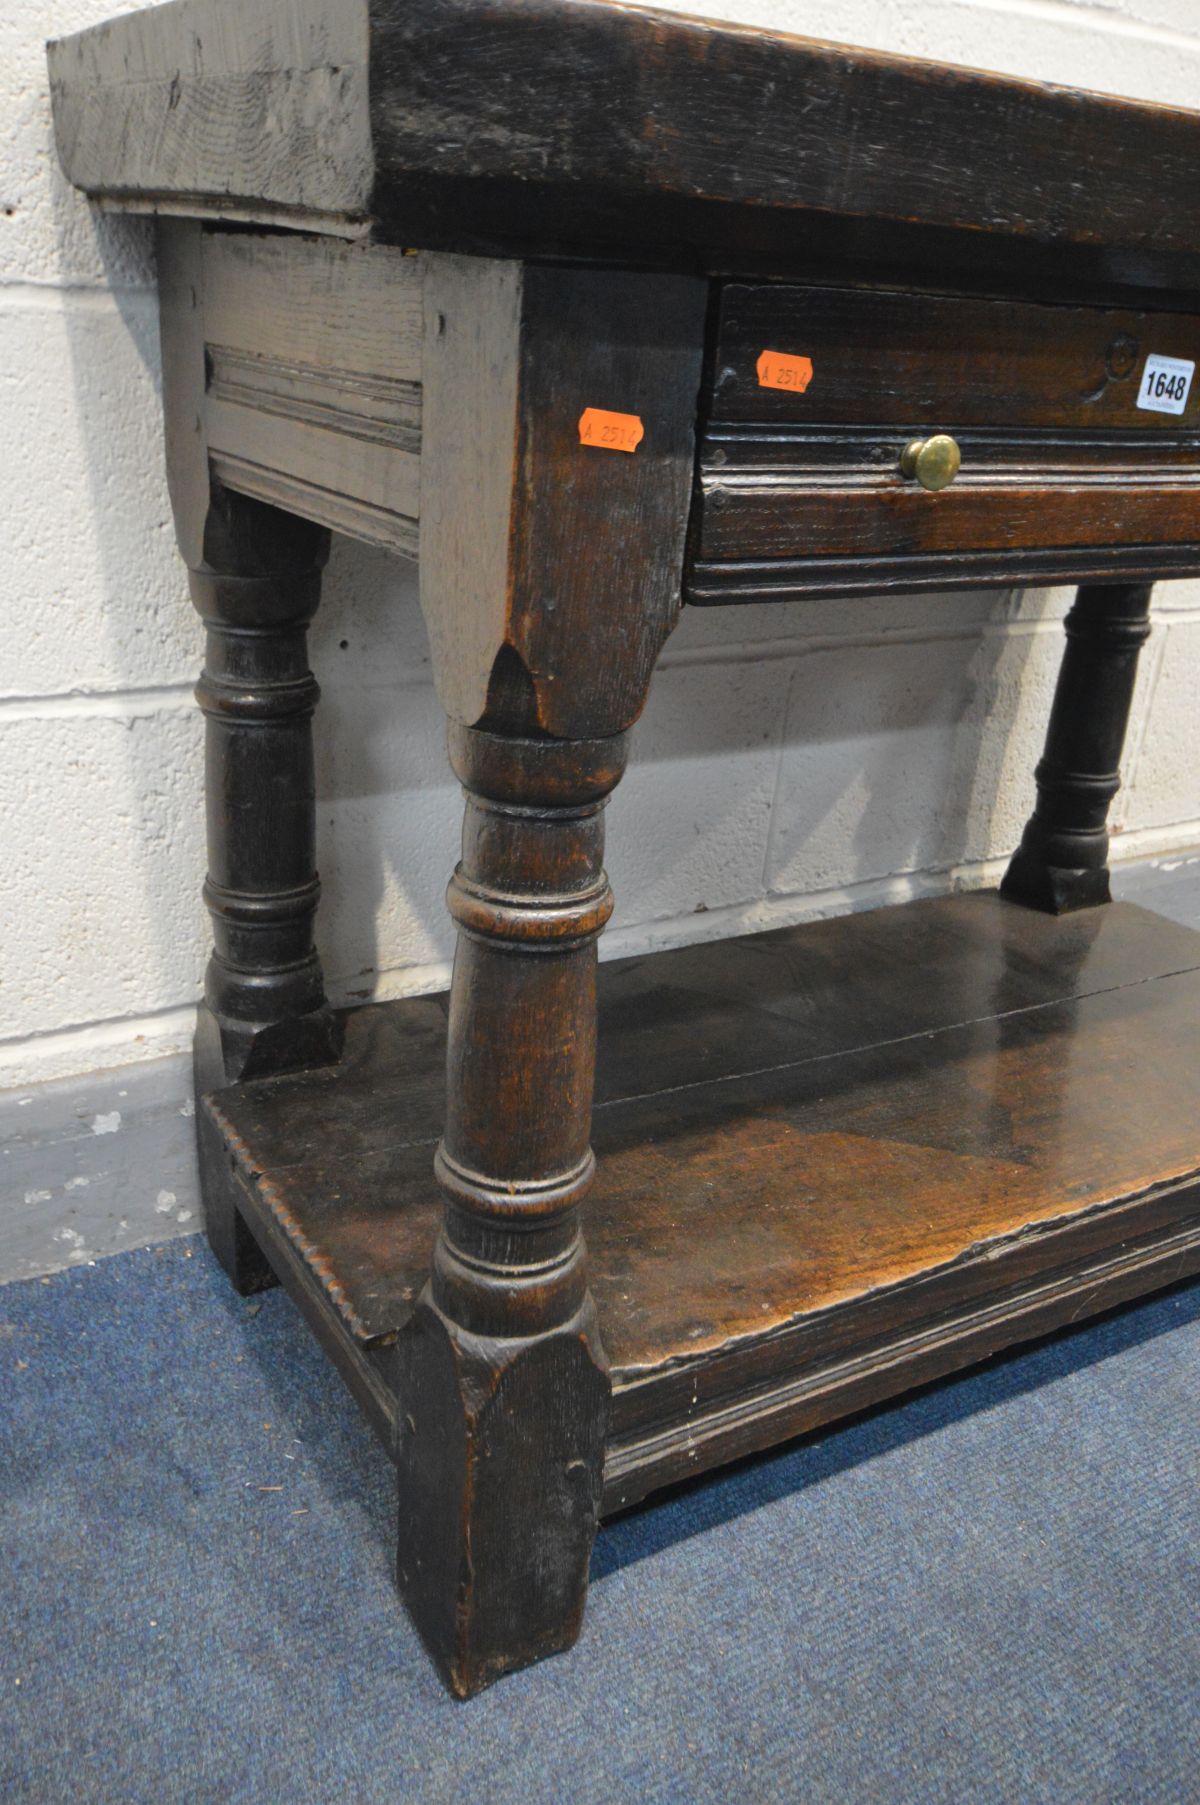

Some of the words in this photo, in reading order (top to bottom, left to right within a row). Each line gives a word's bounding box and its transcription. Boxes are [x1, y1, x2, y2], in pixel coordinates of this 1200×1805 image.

[761, 366, 769, 382] A
[1147, 370, 1187, 401] 1648
[584, 423, 592, 439] A
